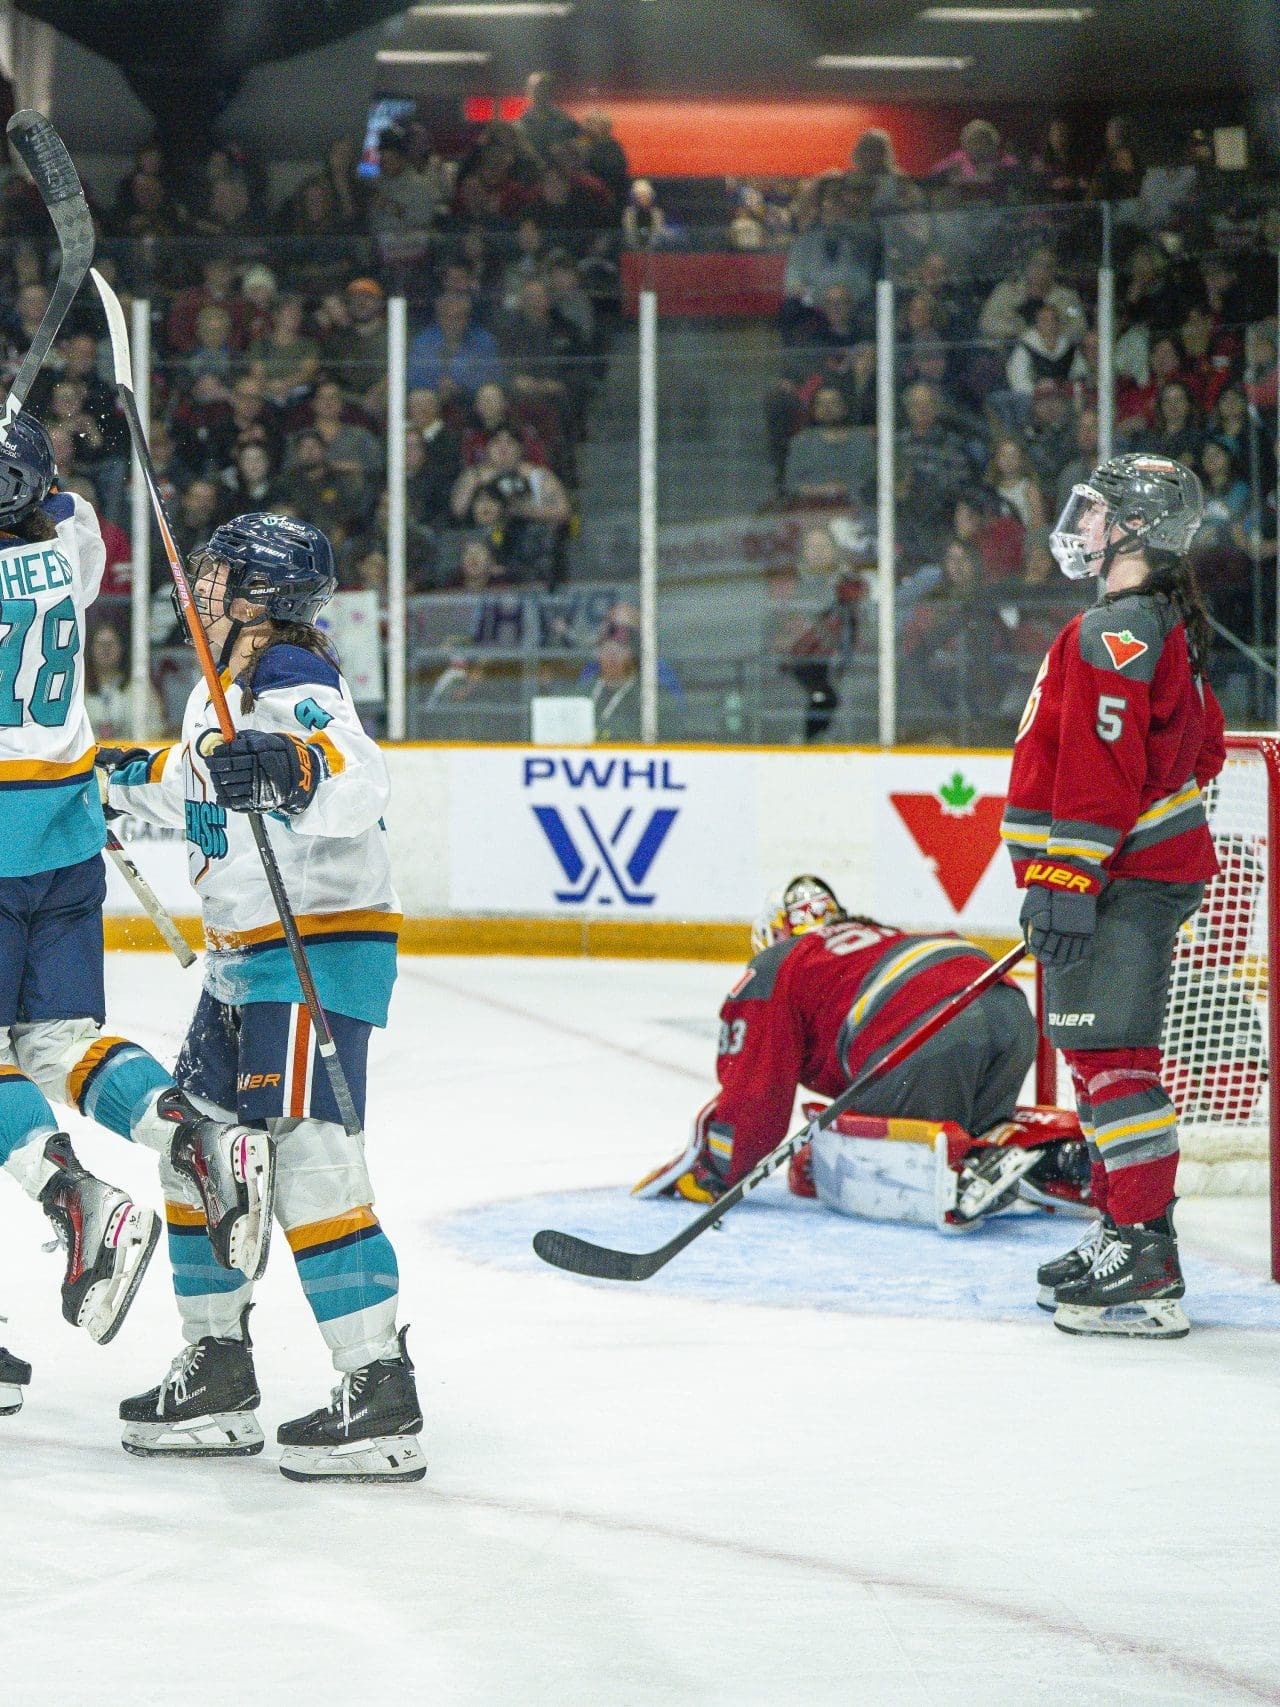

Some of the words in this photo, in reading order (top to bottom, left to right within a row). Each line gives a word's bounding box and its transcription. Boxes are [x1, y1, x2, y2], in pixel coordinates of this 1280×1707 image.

[1095, 692, 1127, 742] 5
[523, 758, 687, 791] PWHL
[1024, 864, 1092, 893] UER
[237, 1073, 281, 1091] UER
[741, 1118, 821, 1199] CCM
[336, 1407, 369, 1430] BUER
